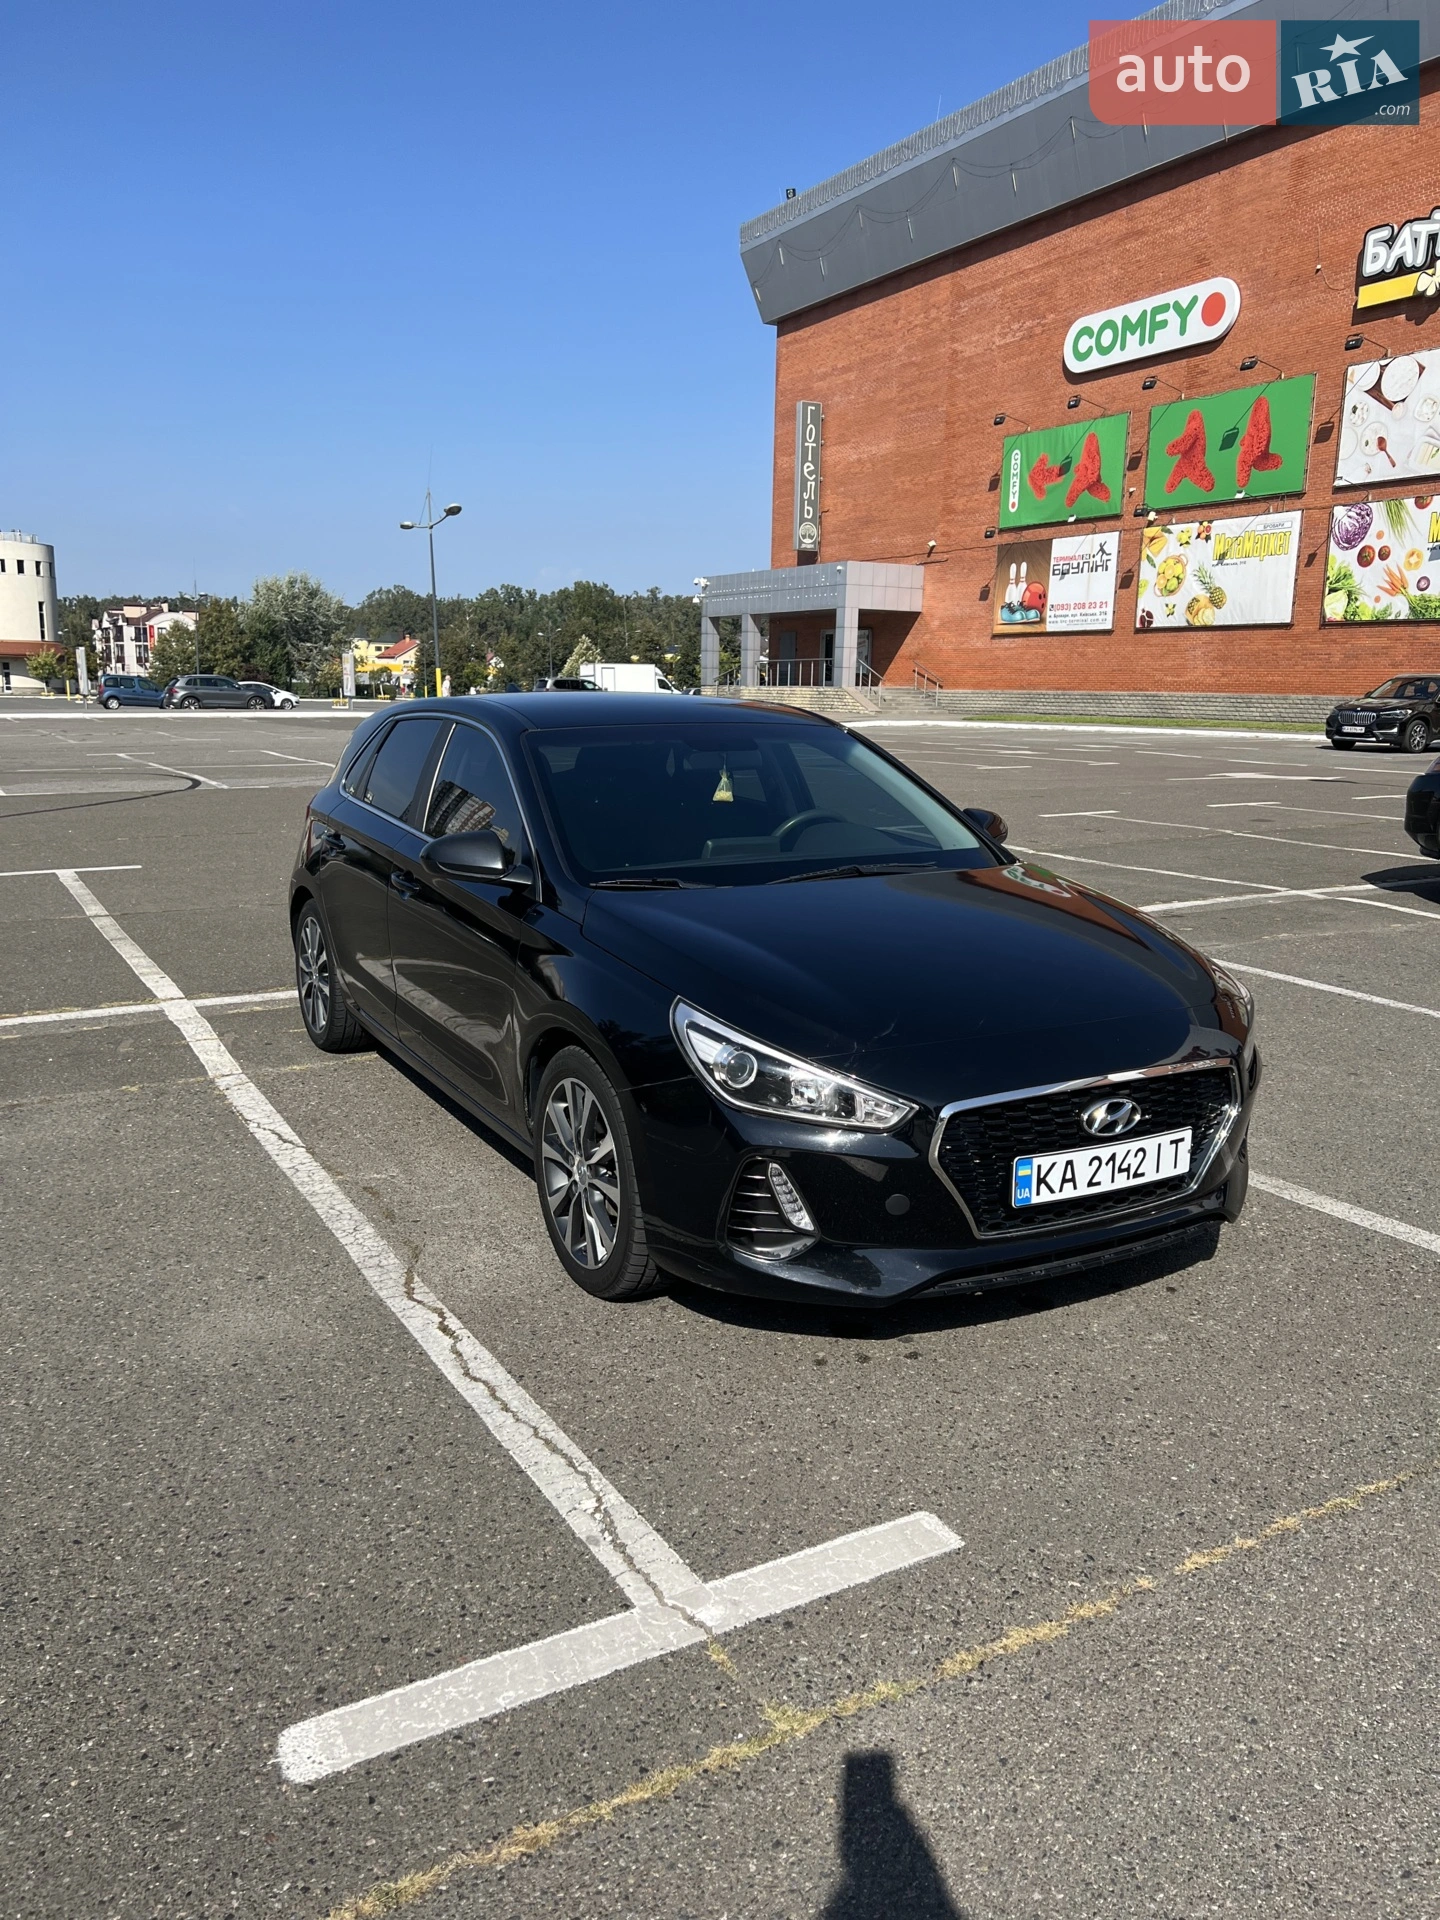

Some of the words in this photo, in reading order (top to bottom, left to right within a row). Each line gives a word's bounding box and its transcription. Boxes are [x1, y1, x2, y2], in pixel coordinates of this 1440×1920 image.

[1362, 209, 1440, 277] БАТ
[1072, 294, 1198, 362] COMFY
[1011, 452, 1019, 499] COMFY
[1212, 530, 1292, 561] МегаМаркет
[1054, 603, 1071, 612] (093)
[1088, 601, 1097, 609] 23
[1035, 1159, 1078, 1197] KA
[1087, 1147, 1147, 1188] 2142
[1156, 1137, 1185, 1174] IT
[1017, 1188, 1030, 1199] UA
